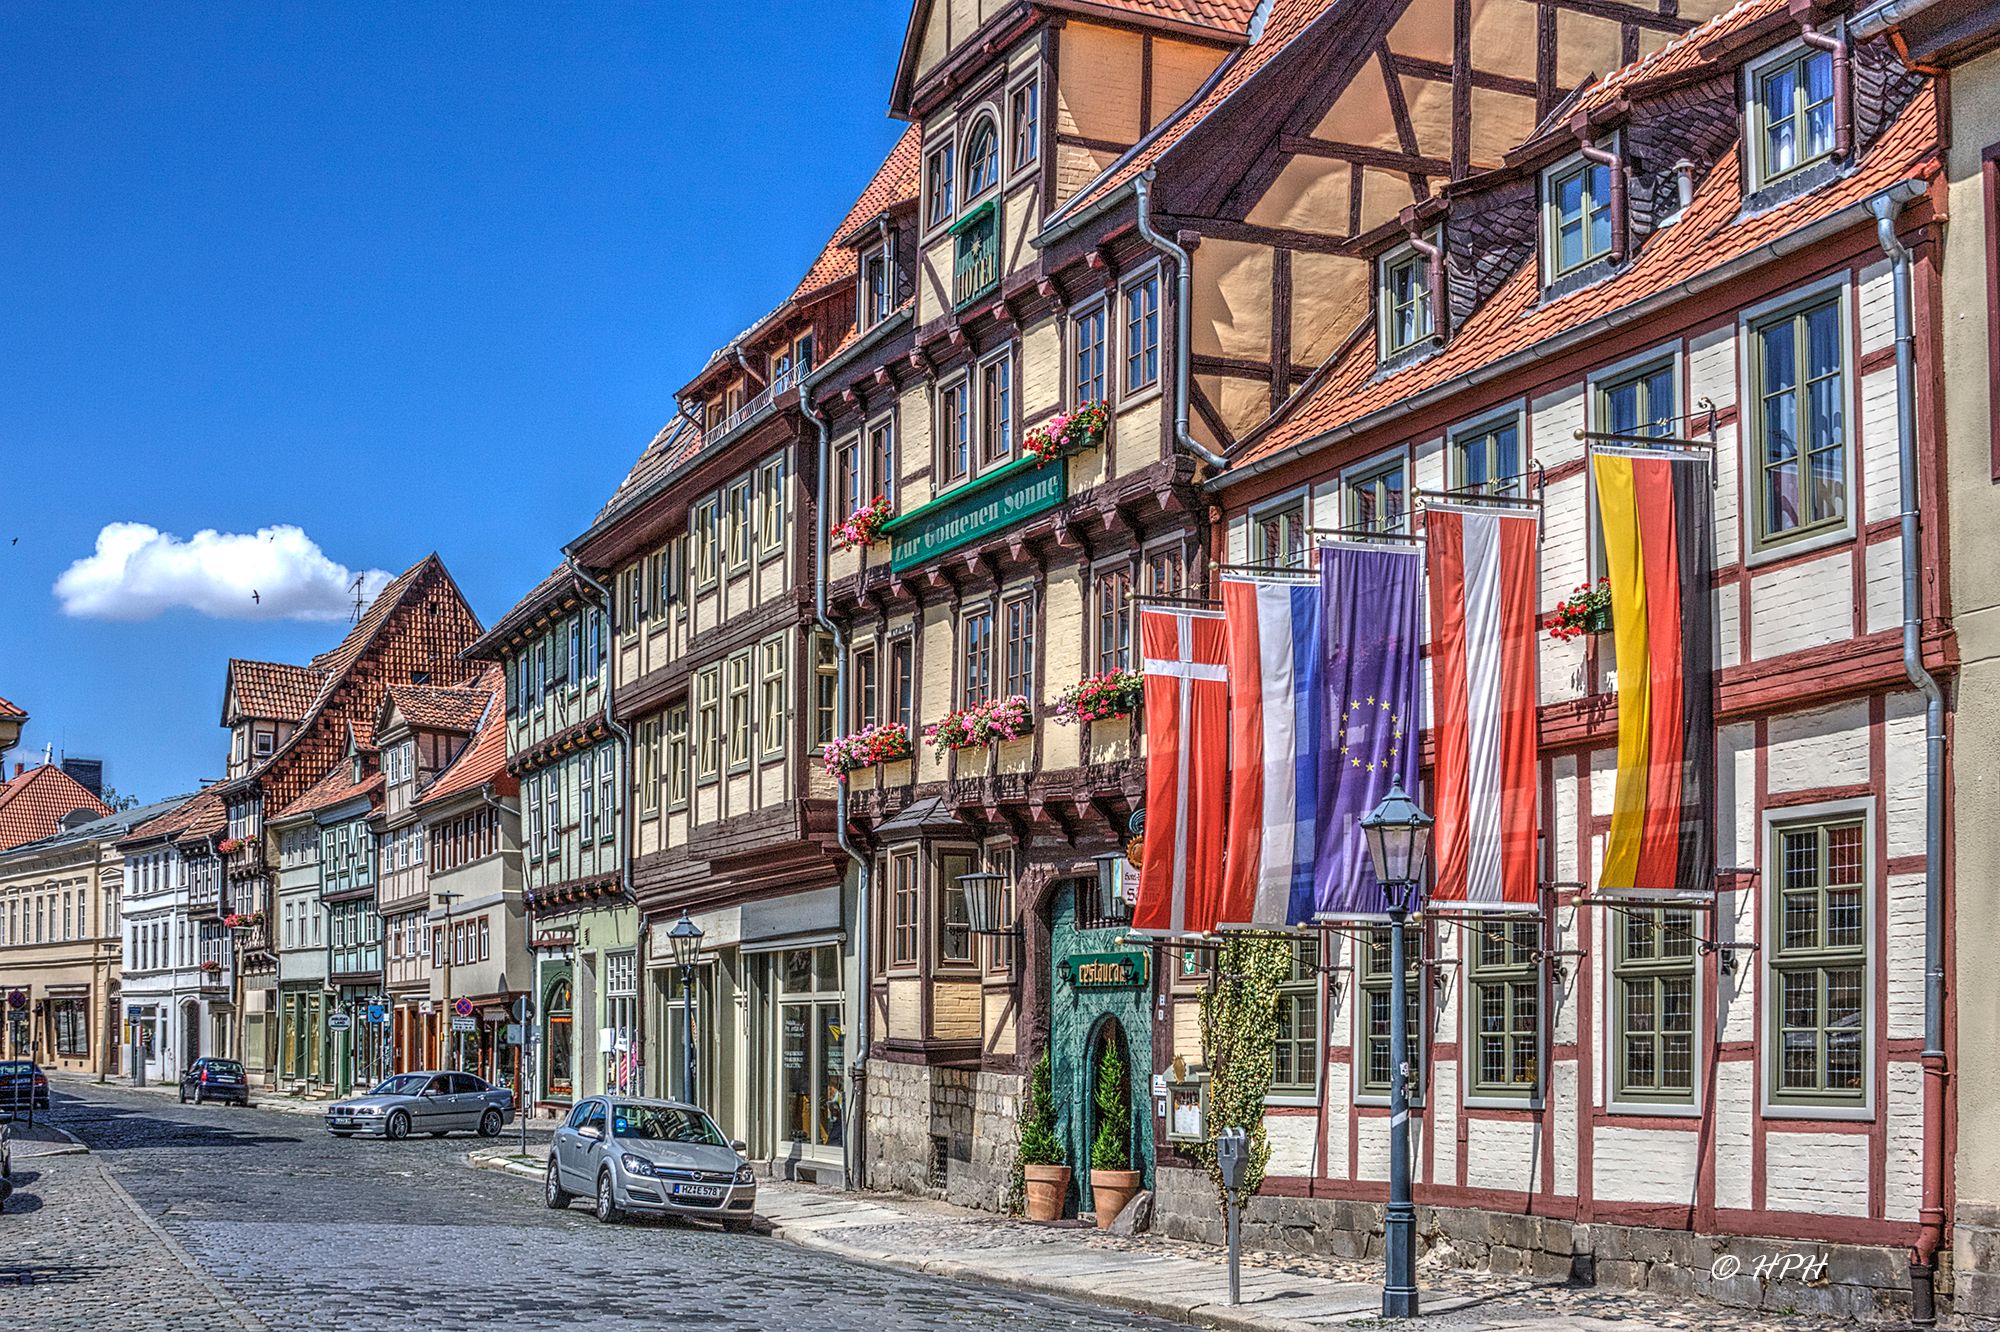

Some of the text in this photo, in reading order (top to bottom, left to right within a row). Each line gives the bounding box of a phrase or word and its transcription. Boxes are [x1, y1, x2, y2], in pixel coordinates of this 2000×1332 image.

[956, 253, 995, 303] HOTEL
[895, 476, 1059, 562] Zur Goldenen Sonne
[1079, 958, 1129, 982] restaura
